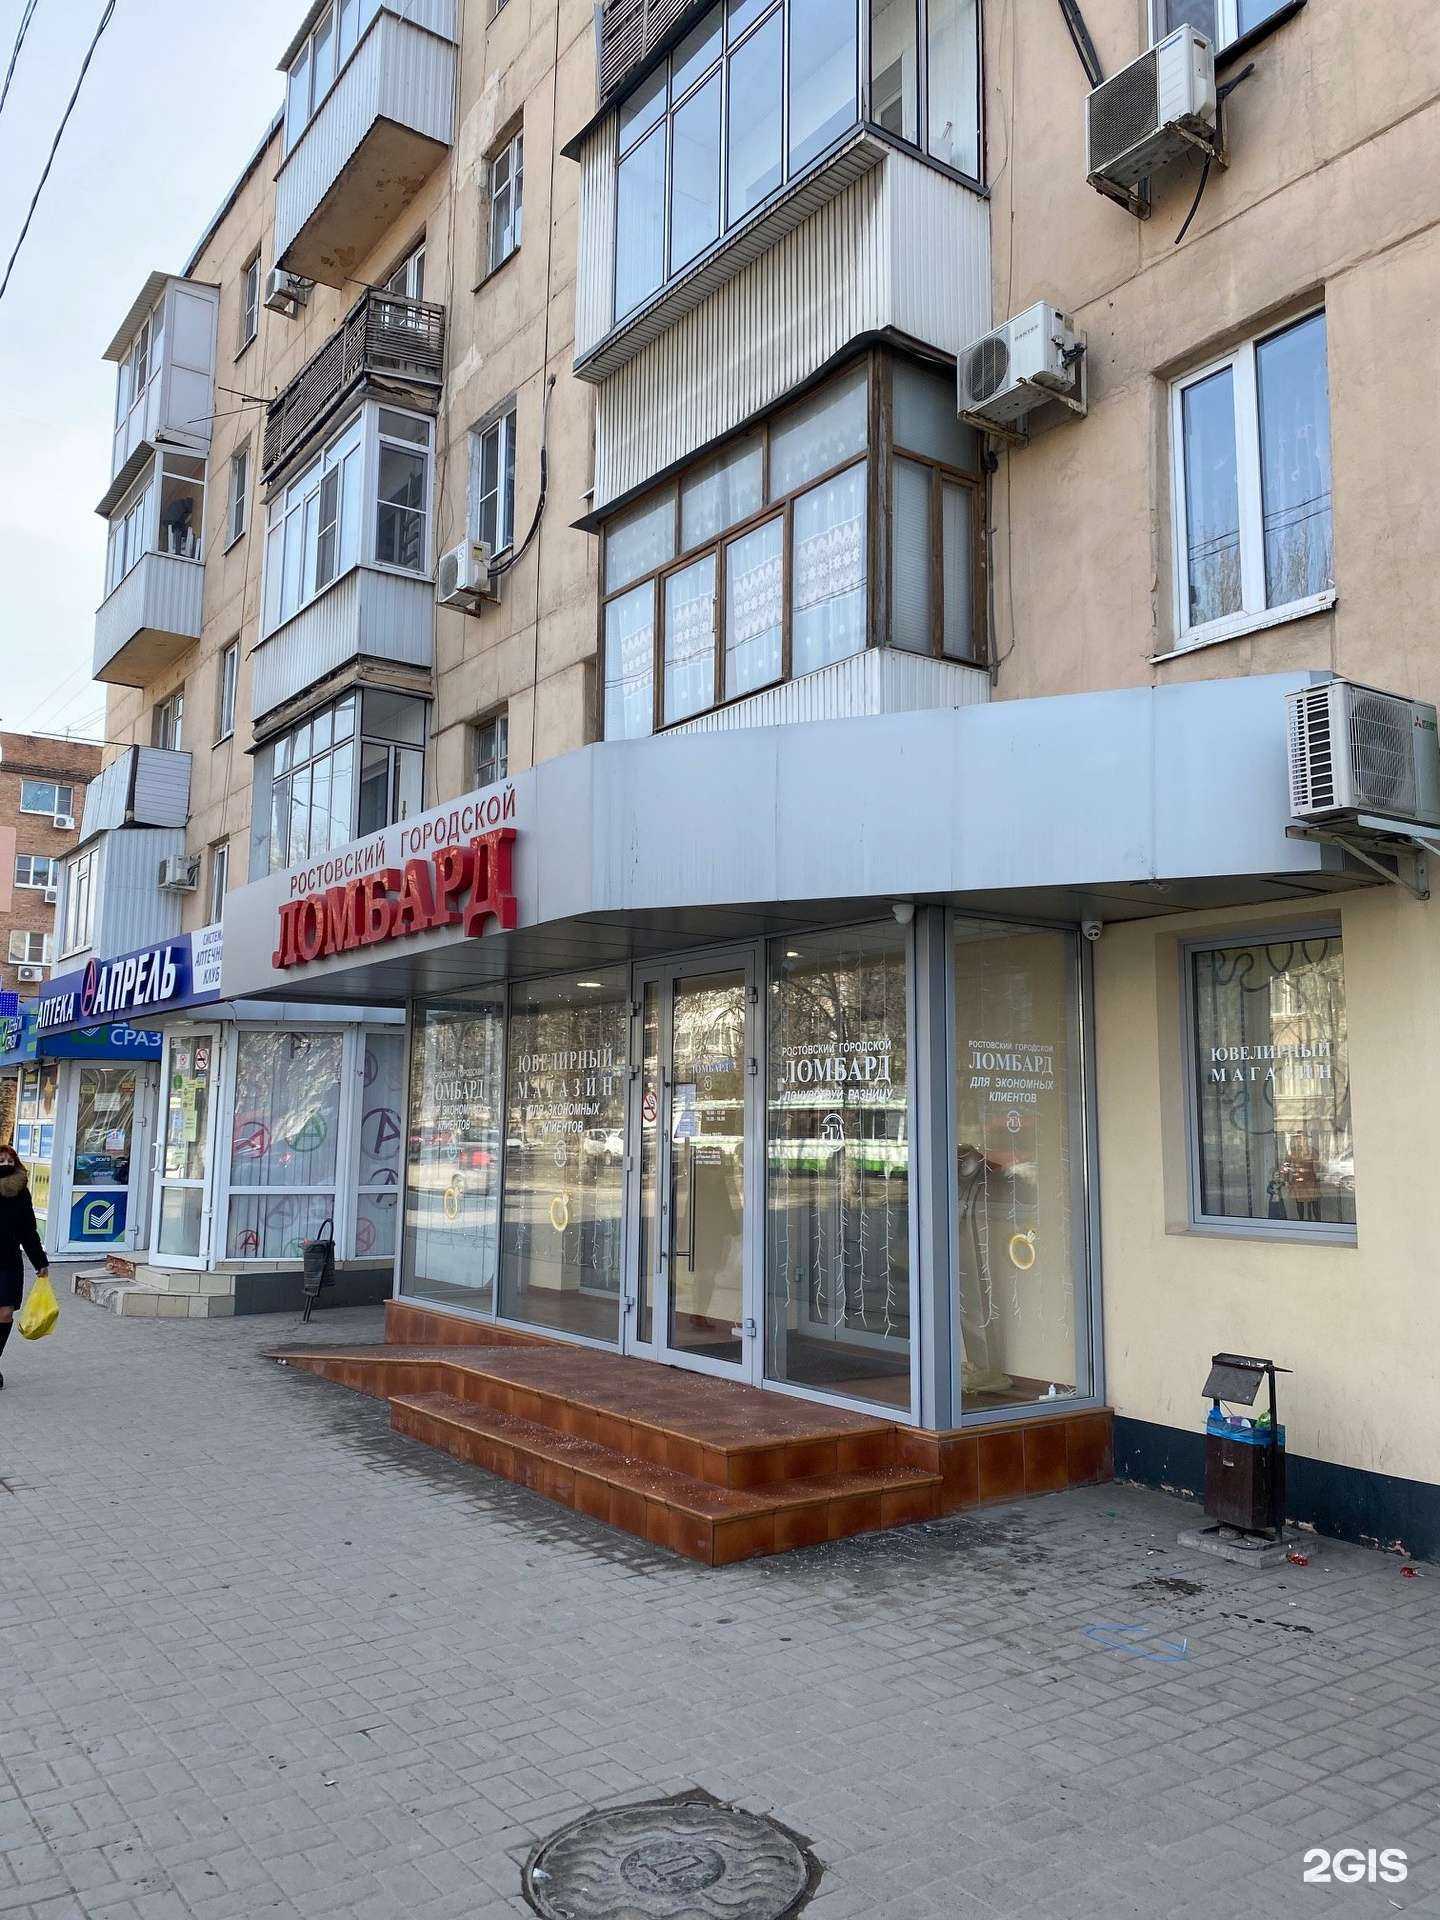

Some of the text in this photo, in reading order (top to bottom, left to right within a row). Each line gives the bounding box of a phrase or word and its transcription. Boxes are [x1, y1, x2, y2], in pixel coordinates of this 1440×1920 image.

[290, 783, 516, 898] РОСТОВСКИЙ ГОРОДСКОЙ
[272, 827, 517, 969] ЛОМБАРД
[203, 966, 220, 985] КЛУБ
[36, 992, 75, 1029] АПТЕКА
[92, 946, 177, 1015] АПРЕЛЬ
[782, 1038, 892, 1056] РОСТОВСКИЙ ГОРОДСКОЙ
[968, 1040, 1012, 1050] РОСТОВСКИЙ
[1210, 1039, 1331, 1061] ЮВЕЛИРНЫЙ
[517, 1042, 613, 1073] ЮВЕЛИРНЫЙ
[968, 1052, 1054, 1076] ЛОМБАРД
[782, 1055, 892, 1087] ЛОМБАРД
[1211, 1063, 1332, 1082] МАГАИН
[517, 1076, 612, 1099] МАГАЗИН
[969, 1076, 1054, 1090] ДЛЯ ЭКОНОМНЫХ
[989, 1091, 1037, 1103] КЛИЕНТОВ
